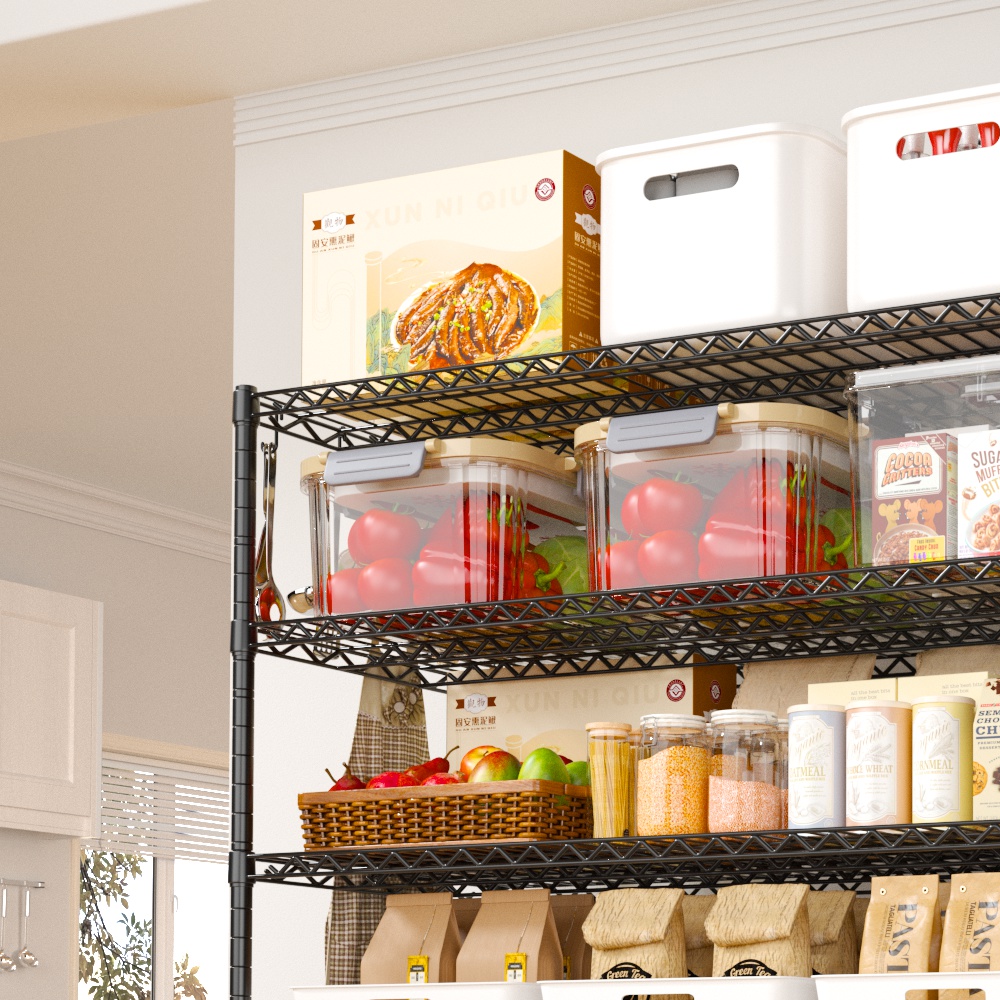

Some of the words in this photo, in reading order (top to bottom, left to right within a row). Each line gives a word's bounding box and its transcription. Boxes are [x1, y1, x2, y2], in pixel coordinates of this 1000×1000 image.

[885, 452, 932, 473] COCOA
[881, 467, 933, 488] CRITTERS
[865, 764, 894, 774] WHEAT
[887, 902, 918, 973] PAST
[968, 900, 999, 972] PAST
[730, 967, 753, 976] Green
